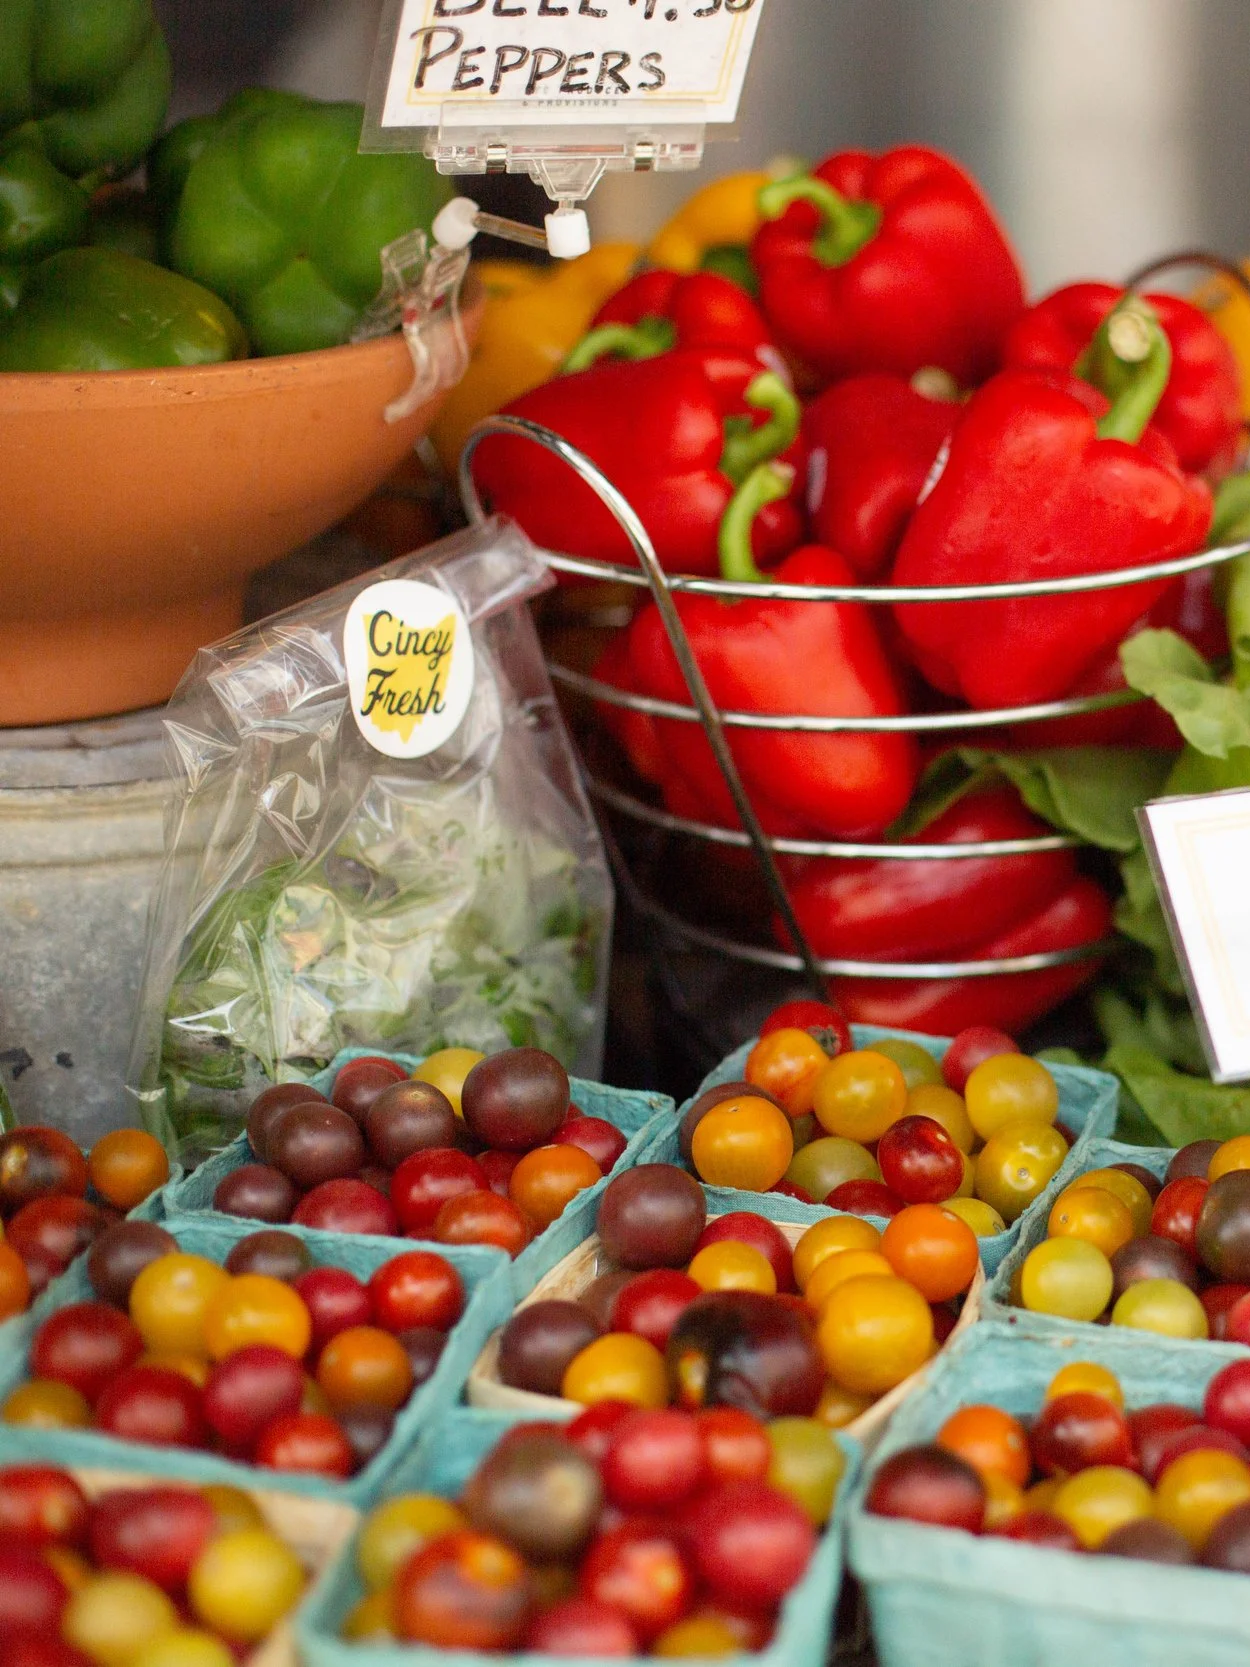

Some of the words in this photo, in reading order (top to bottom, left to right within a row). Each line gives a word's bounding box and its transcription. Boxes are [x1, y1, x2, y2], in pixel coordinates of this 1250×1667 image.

[410, 26, 666, 95] PEPPERS
[369, 610, 453, 671] Cincy
[360, 668, 446, 717] Fresh
